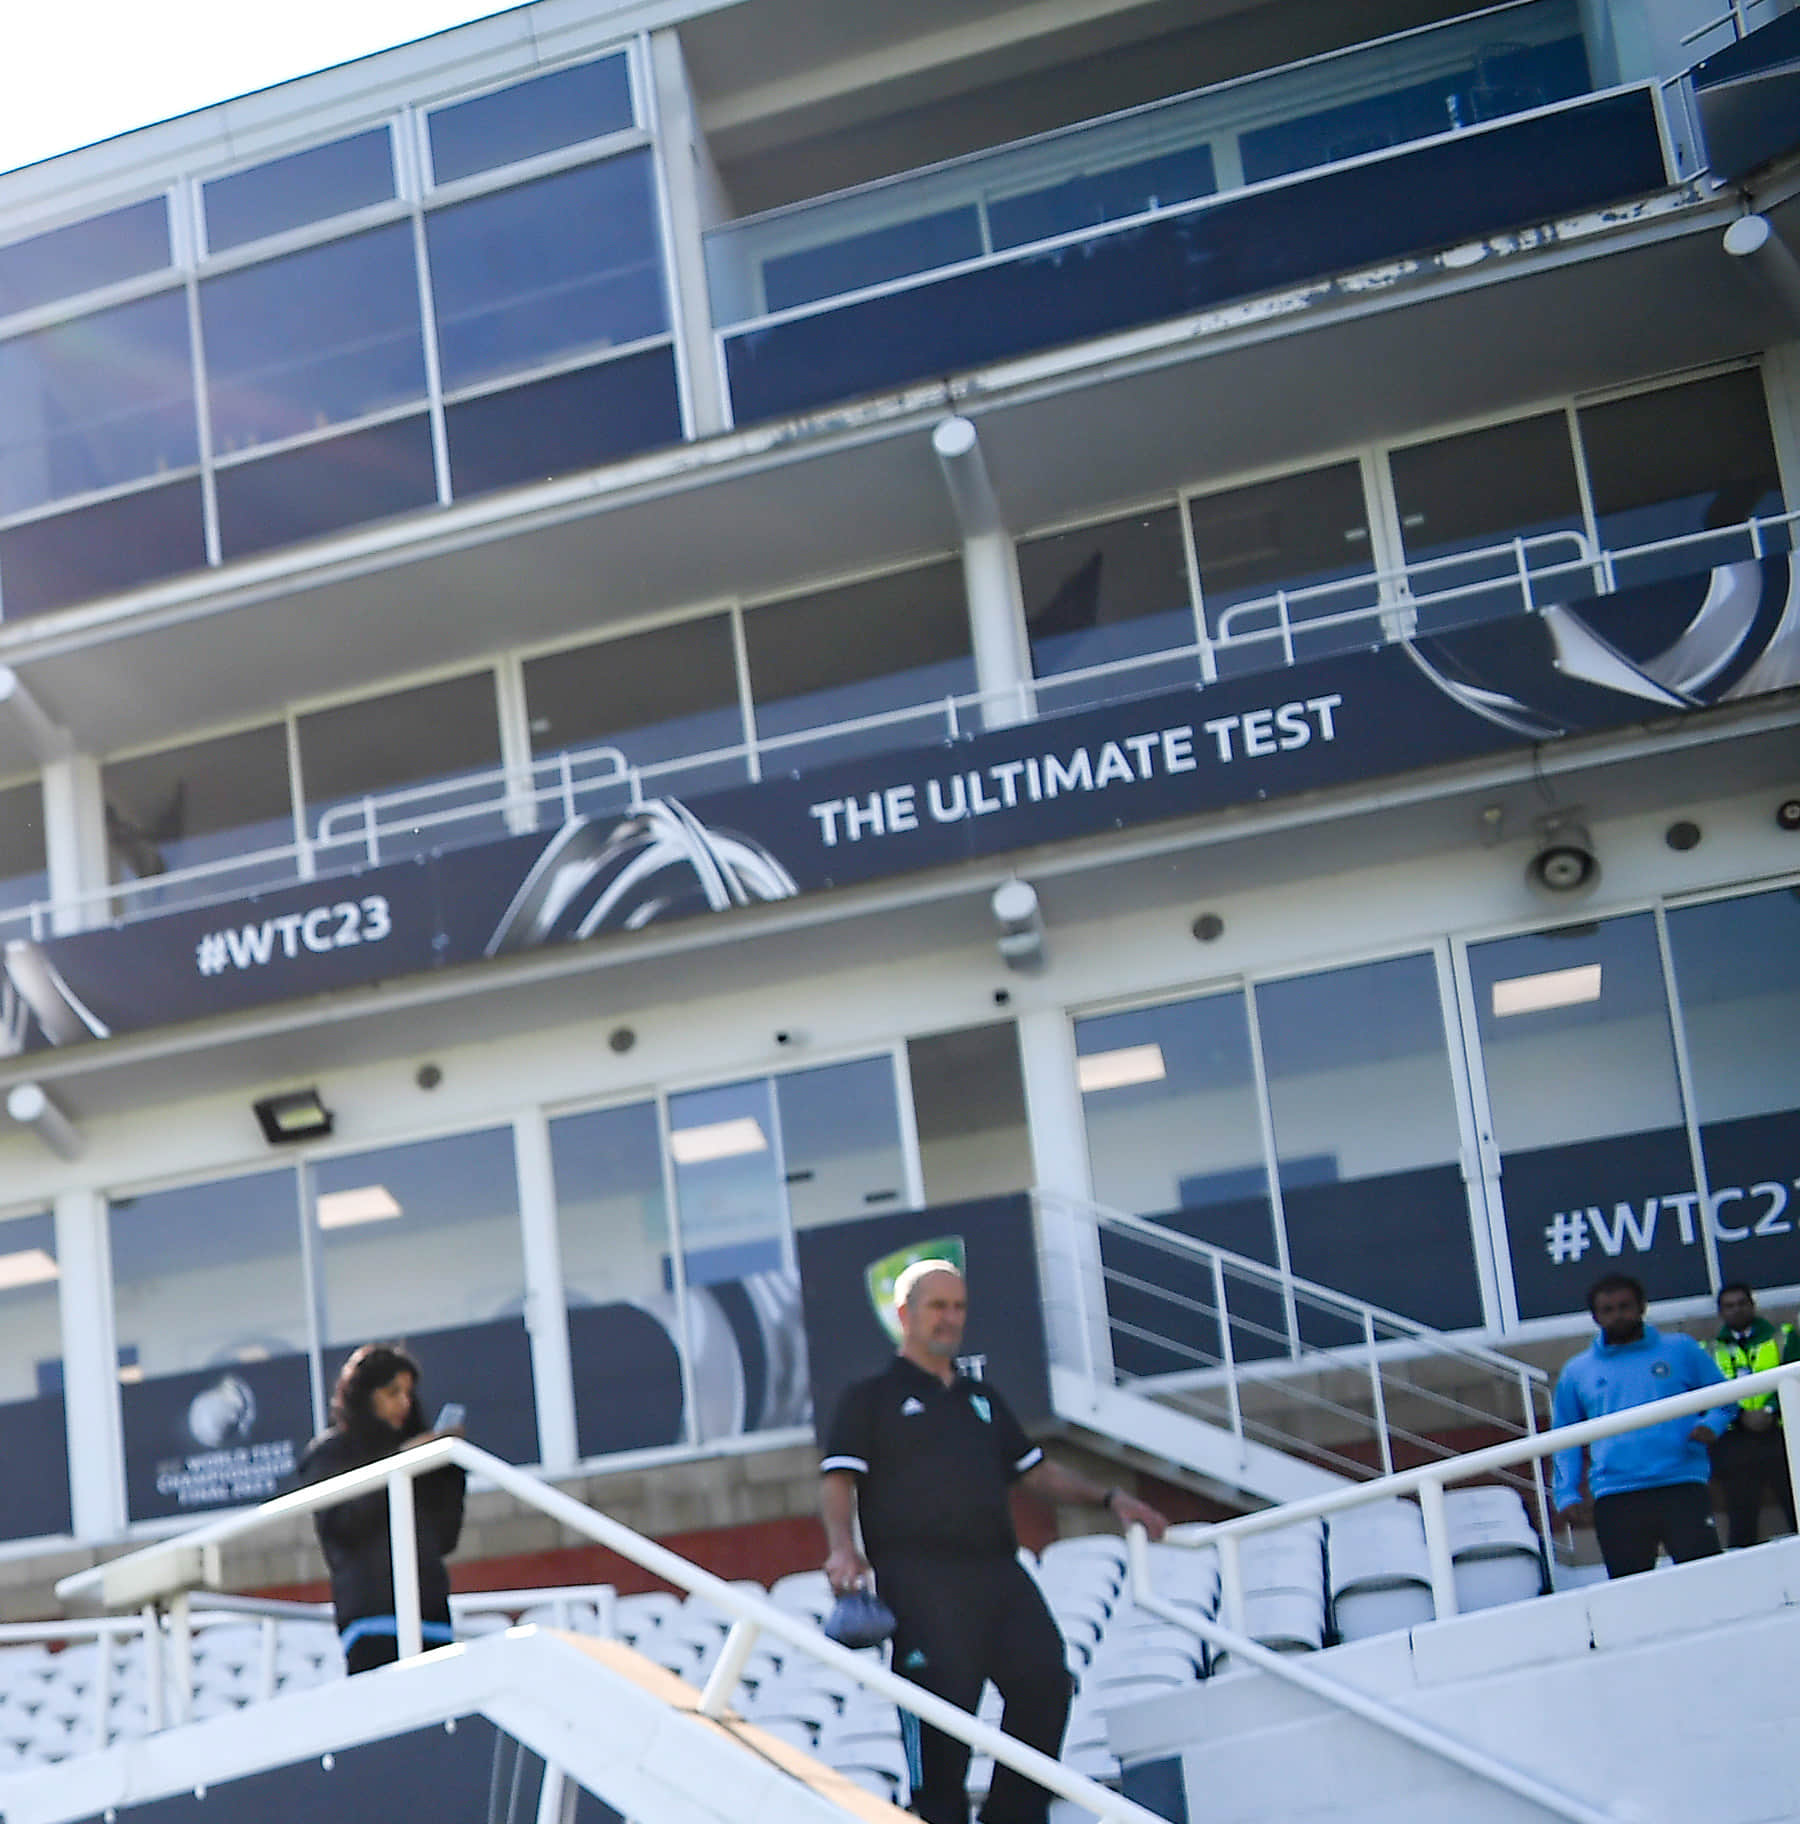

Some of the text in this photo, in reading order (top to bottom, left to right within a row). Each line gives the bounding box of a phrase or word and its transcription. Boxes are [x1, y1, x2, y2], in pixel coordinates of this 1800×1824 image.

[809, 693, 1343, 847] THE ULTIMATE TEST
[196, 895, 392, 976] #WTC23
[1543, 1178, 1800, 1264] #WTC2
